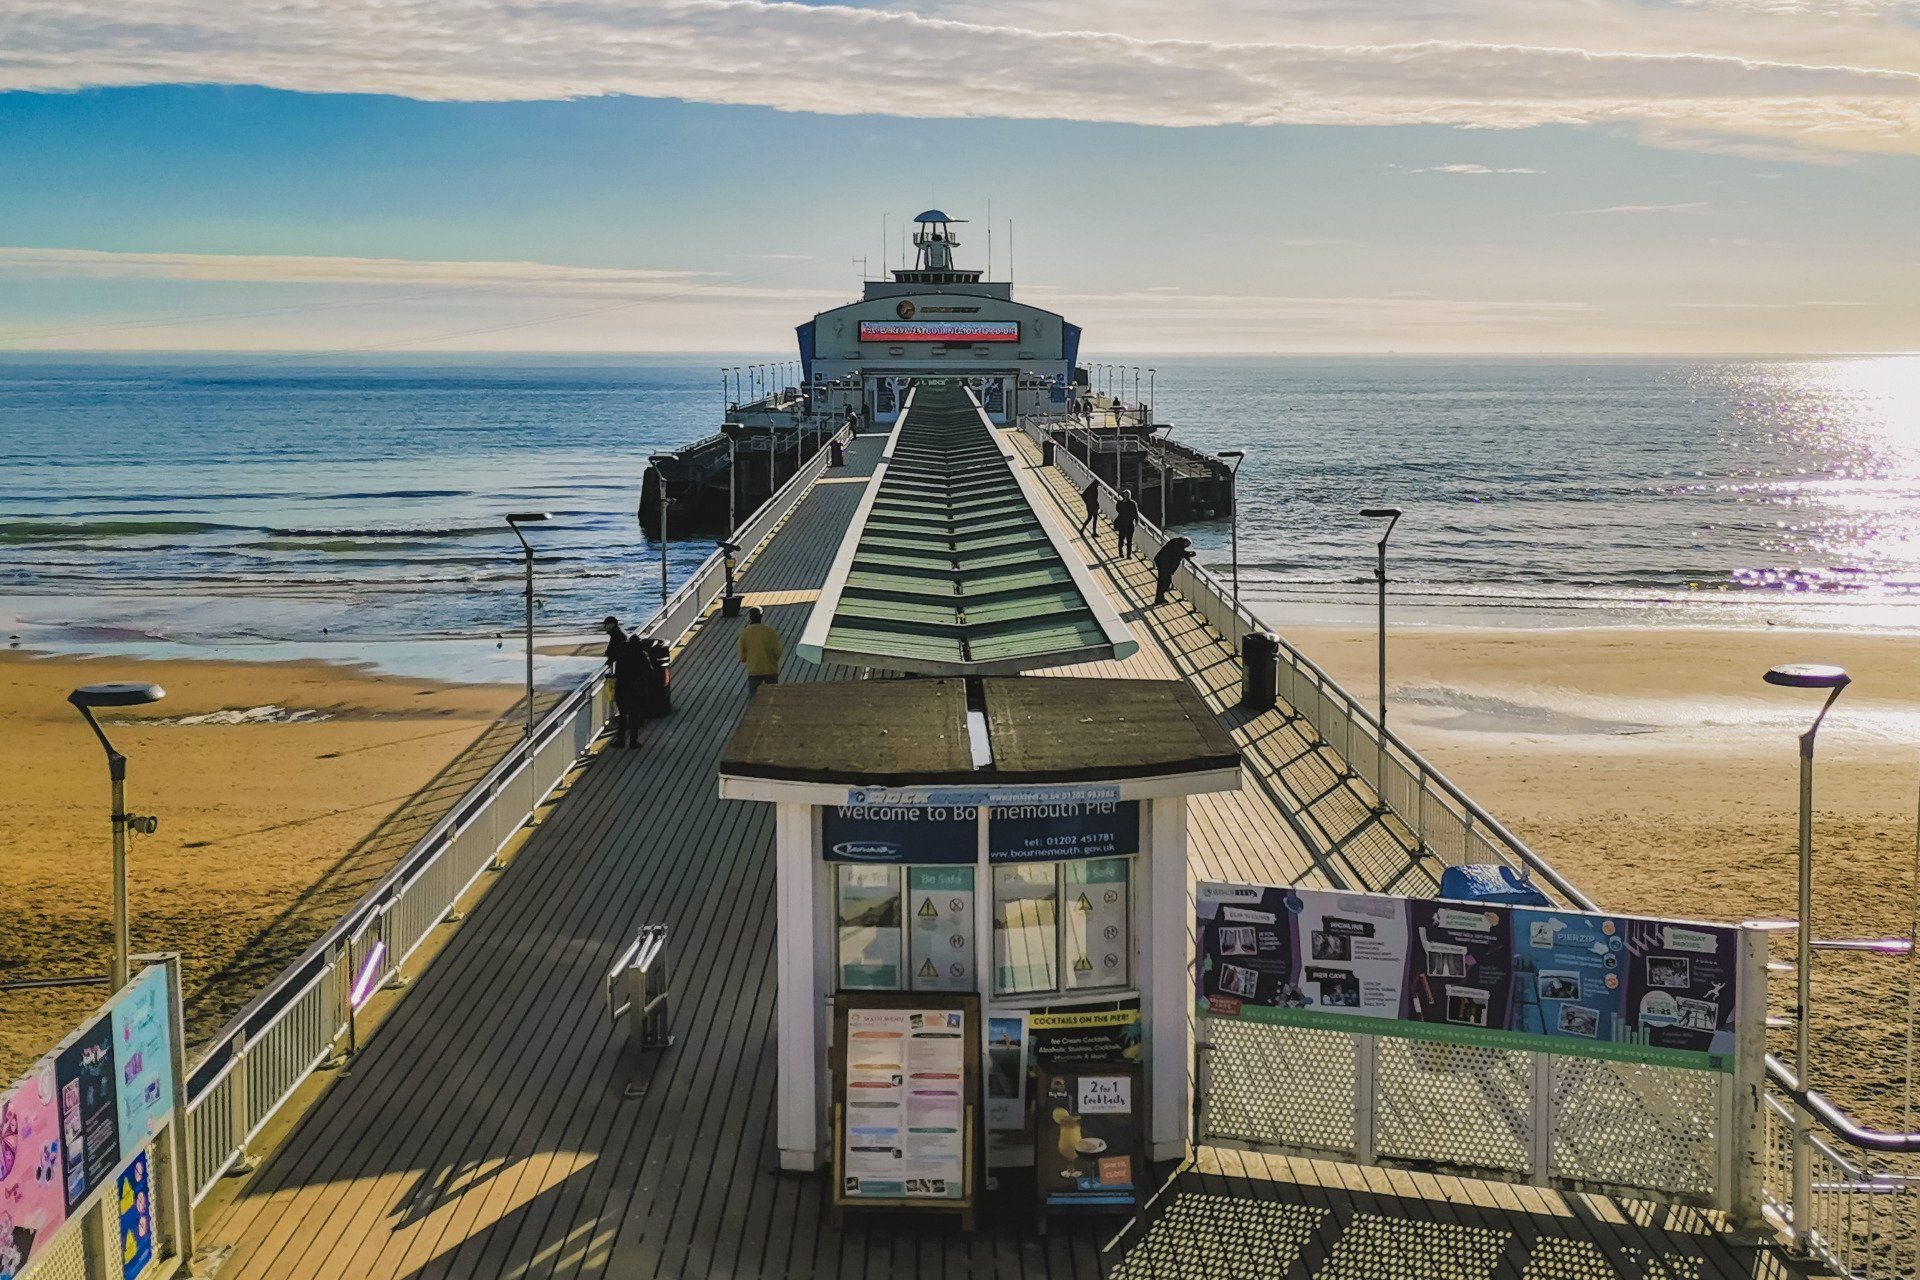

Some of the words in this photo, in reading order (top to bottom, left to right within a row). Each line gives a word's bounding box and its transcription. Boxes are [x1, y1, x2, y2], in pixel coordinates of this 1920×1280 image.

[838, 805, 921, 821] Welcome
[927, 807, 947, 821] to
[953, 802, 1078, 820] Bornemouth
[1046, 836, 1077, 846] 01202
[990, 843, 1115, 858] ww.bournemouth.gov.uk
[938, 873, 962, 885] Safe
[1557, 932, 1596, 943] PIERZIP
[1328, 972, 1347, 981] CAVE
[1034, 1016, 1077, 1026] COCKTAILS
[1078, 1016, 1092, 1024] ON
[1094, 1015, 1108, 1023] THE
[1062, 1036, 1082, 1044] Cream
[1480, 1034, 1551, 1047] BOURNEMOUTH
[1091, 1081, 1098, 1093] 2
[1100, 1084, 1111, 1093] for
[1113, 1081, 1118, 1093] 1
[1083, 1095, 1126, 1106] Cocktails
